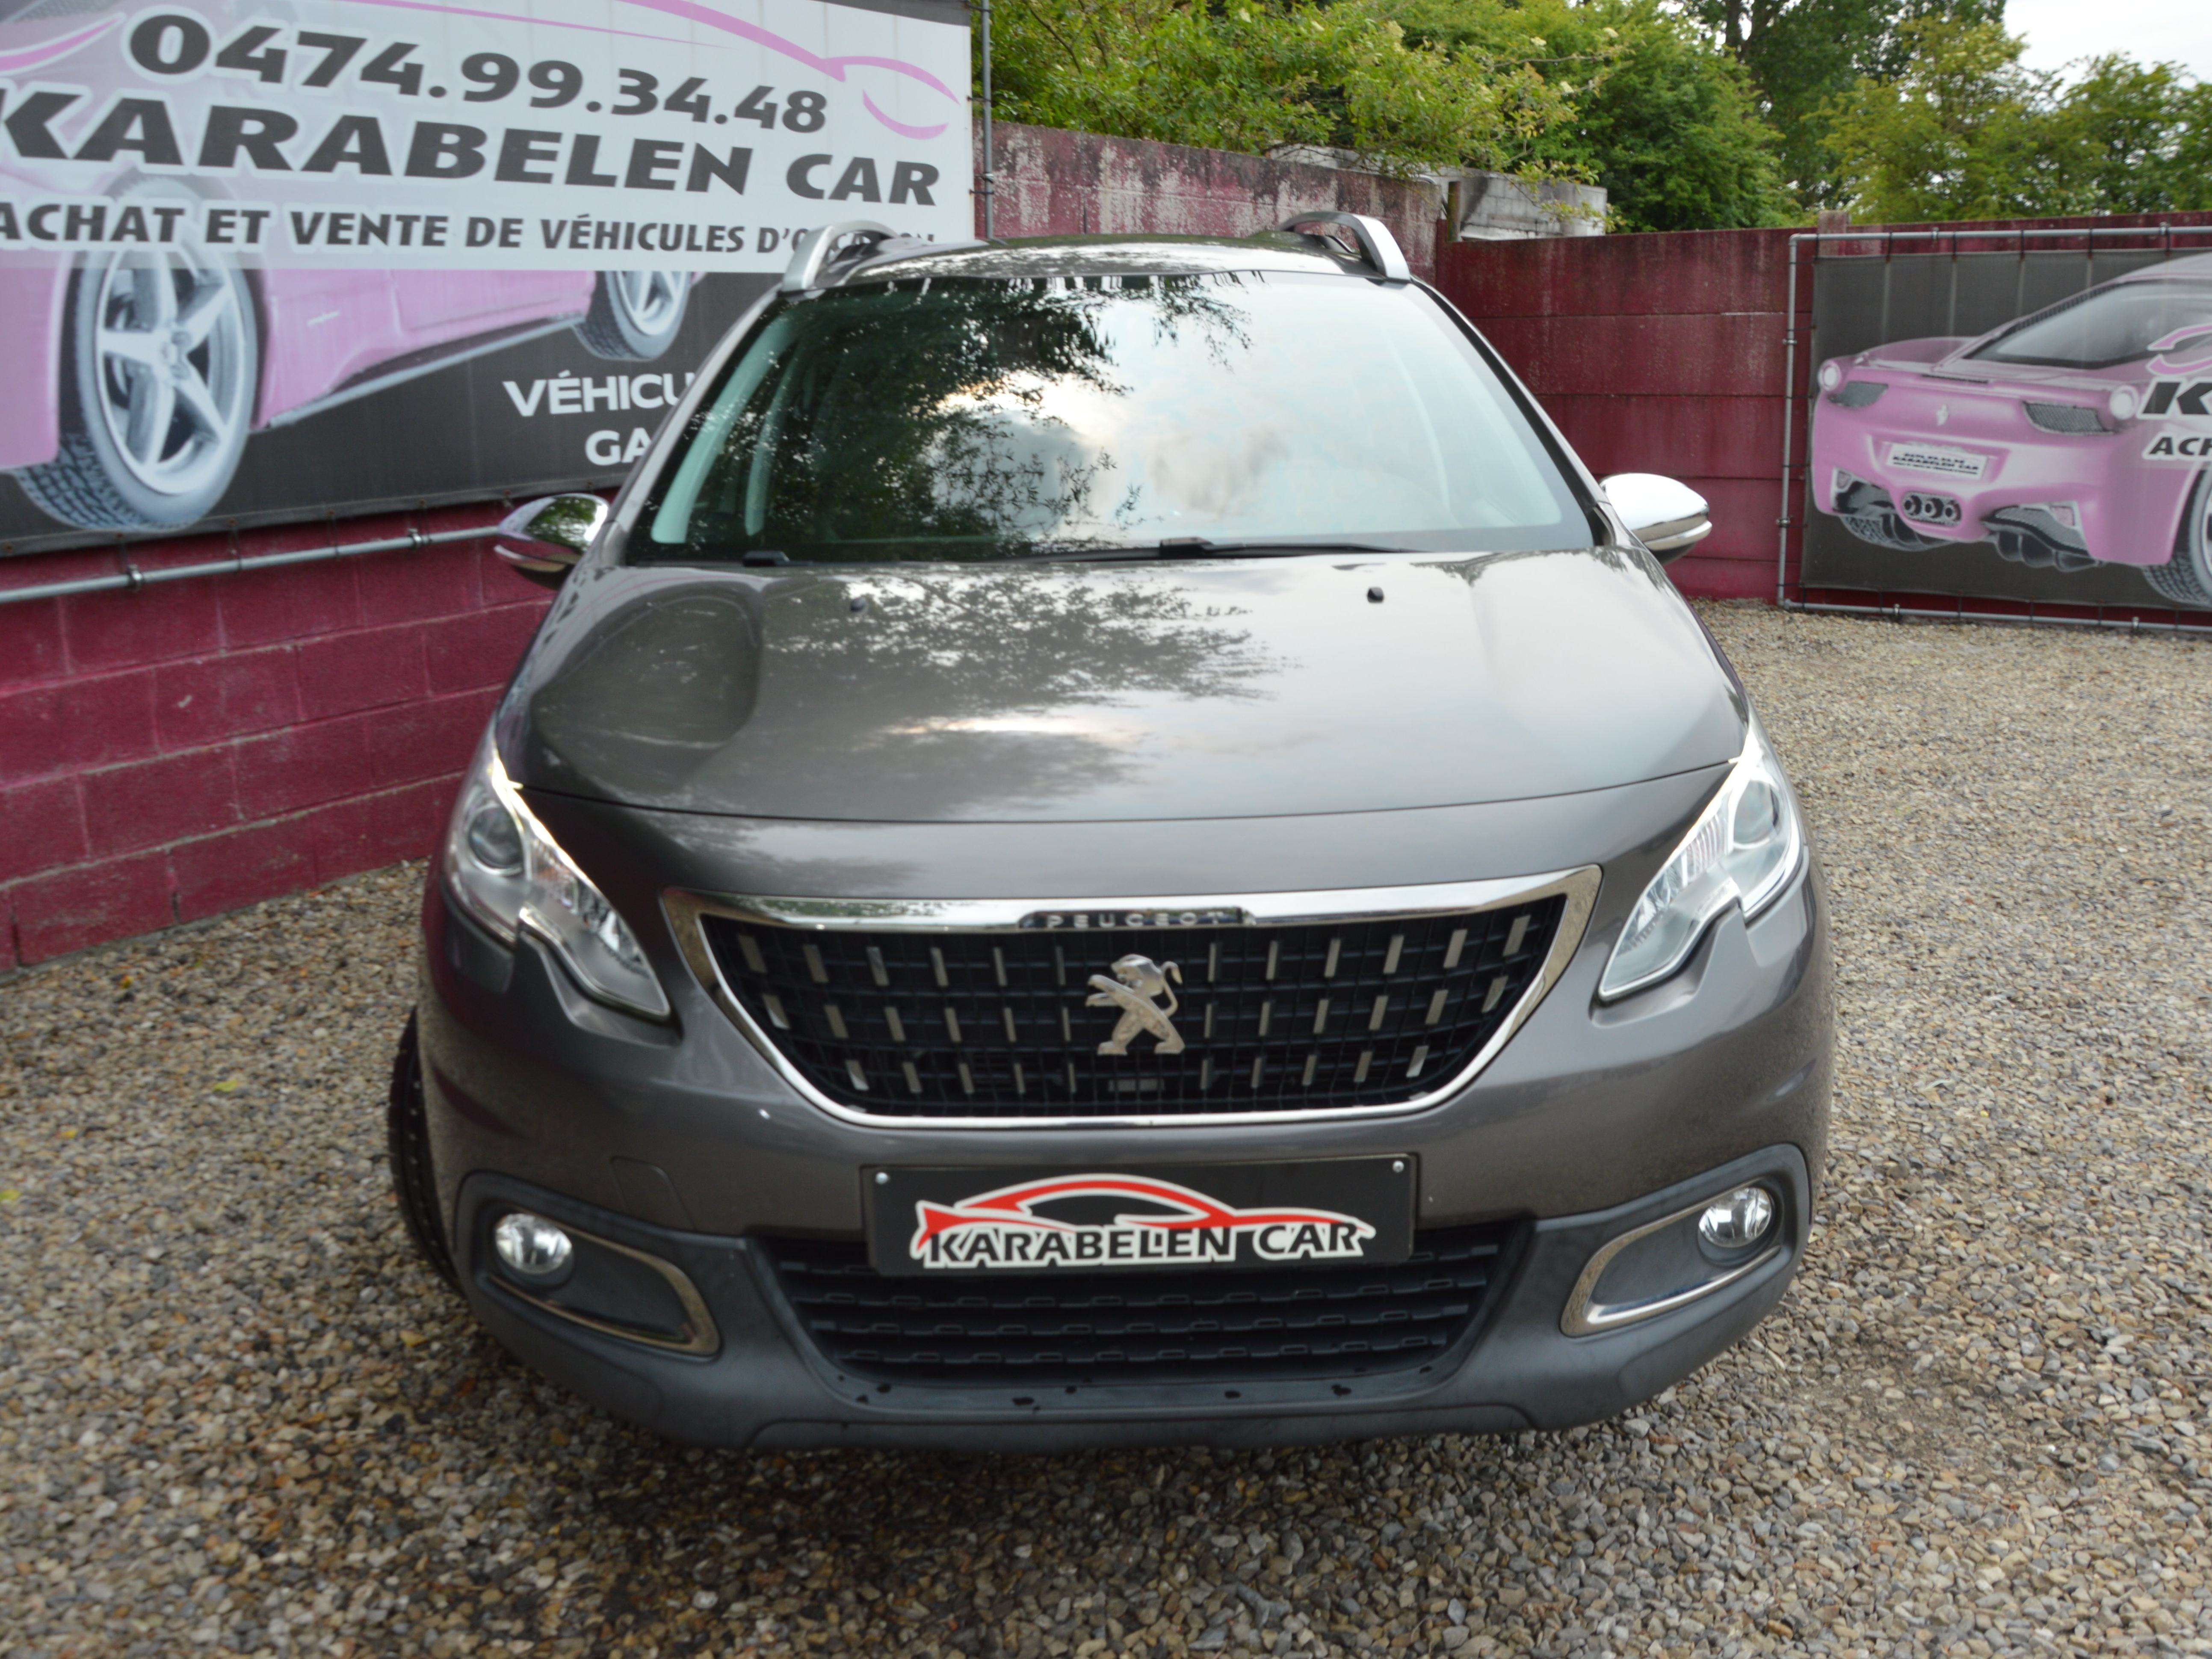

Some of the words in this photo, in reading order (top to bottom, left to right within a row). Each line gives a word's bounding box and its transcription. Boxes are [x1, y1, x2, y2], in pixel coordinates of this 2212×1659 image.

[130, 15, 827, 133] 0474.99.34.48
[0, 88, 753, 195] KARABELEN
[786, 154, 939, 206] CAR
[0, 202, 185, 242] ACHAT
[205, 209, 270, 243] ET
[290, 211, 448, 247] VENTE
[465, 217, 523, 248] DE
[541, 213, 745, 253] VÉHICULES
[1047, 911, 1224, 929] PEUGEOT
[930, 1227, 1231, 1262] KARABELEN
[1259, 1222, 1357, 1253] CAR
